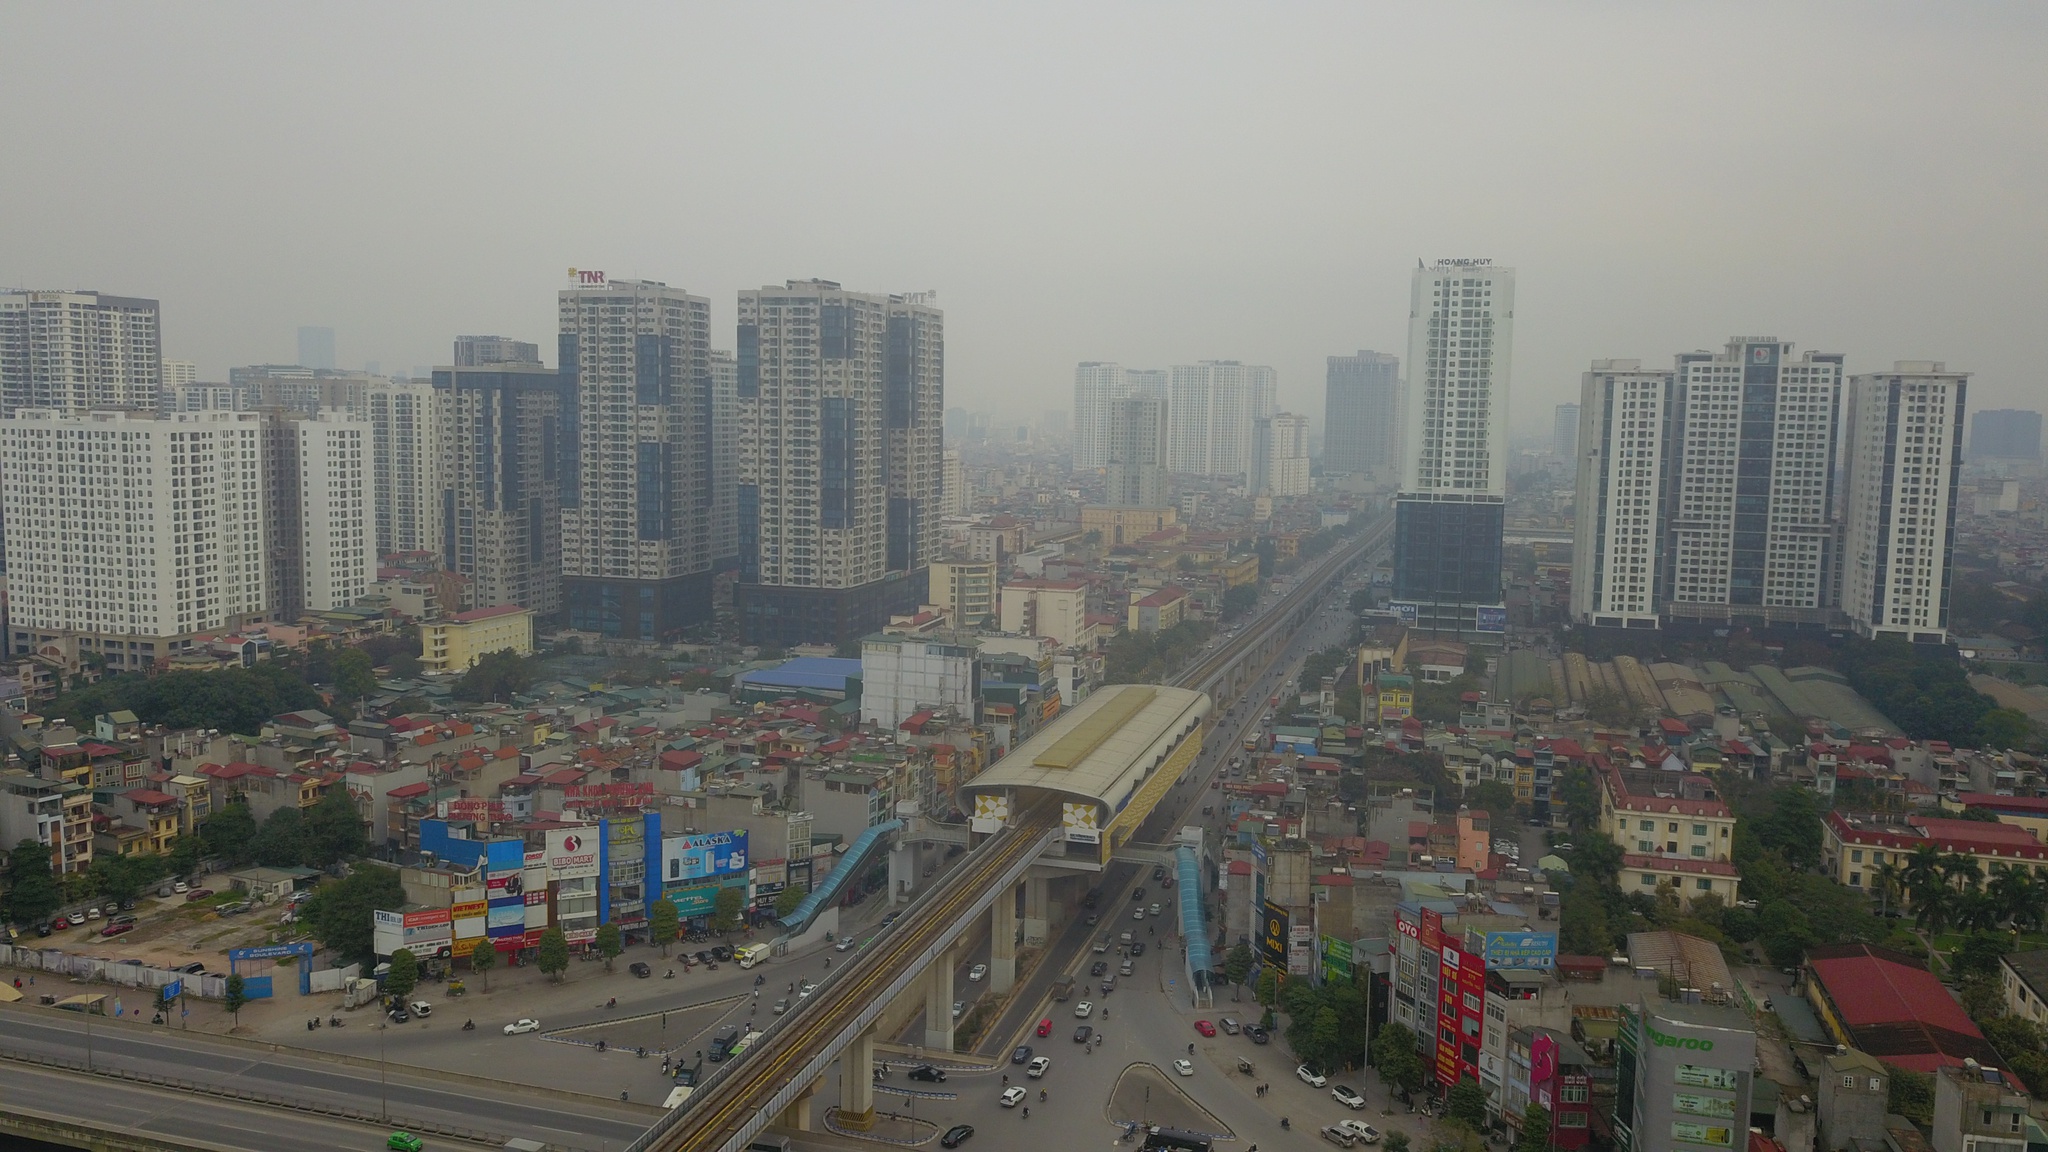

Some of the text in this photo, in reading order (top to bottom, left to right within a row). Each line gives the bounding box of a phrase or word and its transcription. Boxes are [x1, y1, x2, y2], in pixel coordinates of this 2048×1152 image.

[1437, 258, 1493, 266] HOANG HUY
[577, 270, 605, 284] TNR
[692, 834, 732, 848] ALASKA
[553, 855, 572, 866] BIBO
[573, 853, 594, 865] MART
[376, 911, 390, 922] THI
[1398, 921, 1418, 938] OYO
[1266, 936, 1283, 954] MIXI
[249, 950, 292, 958] BOULEVARD
